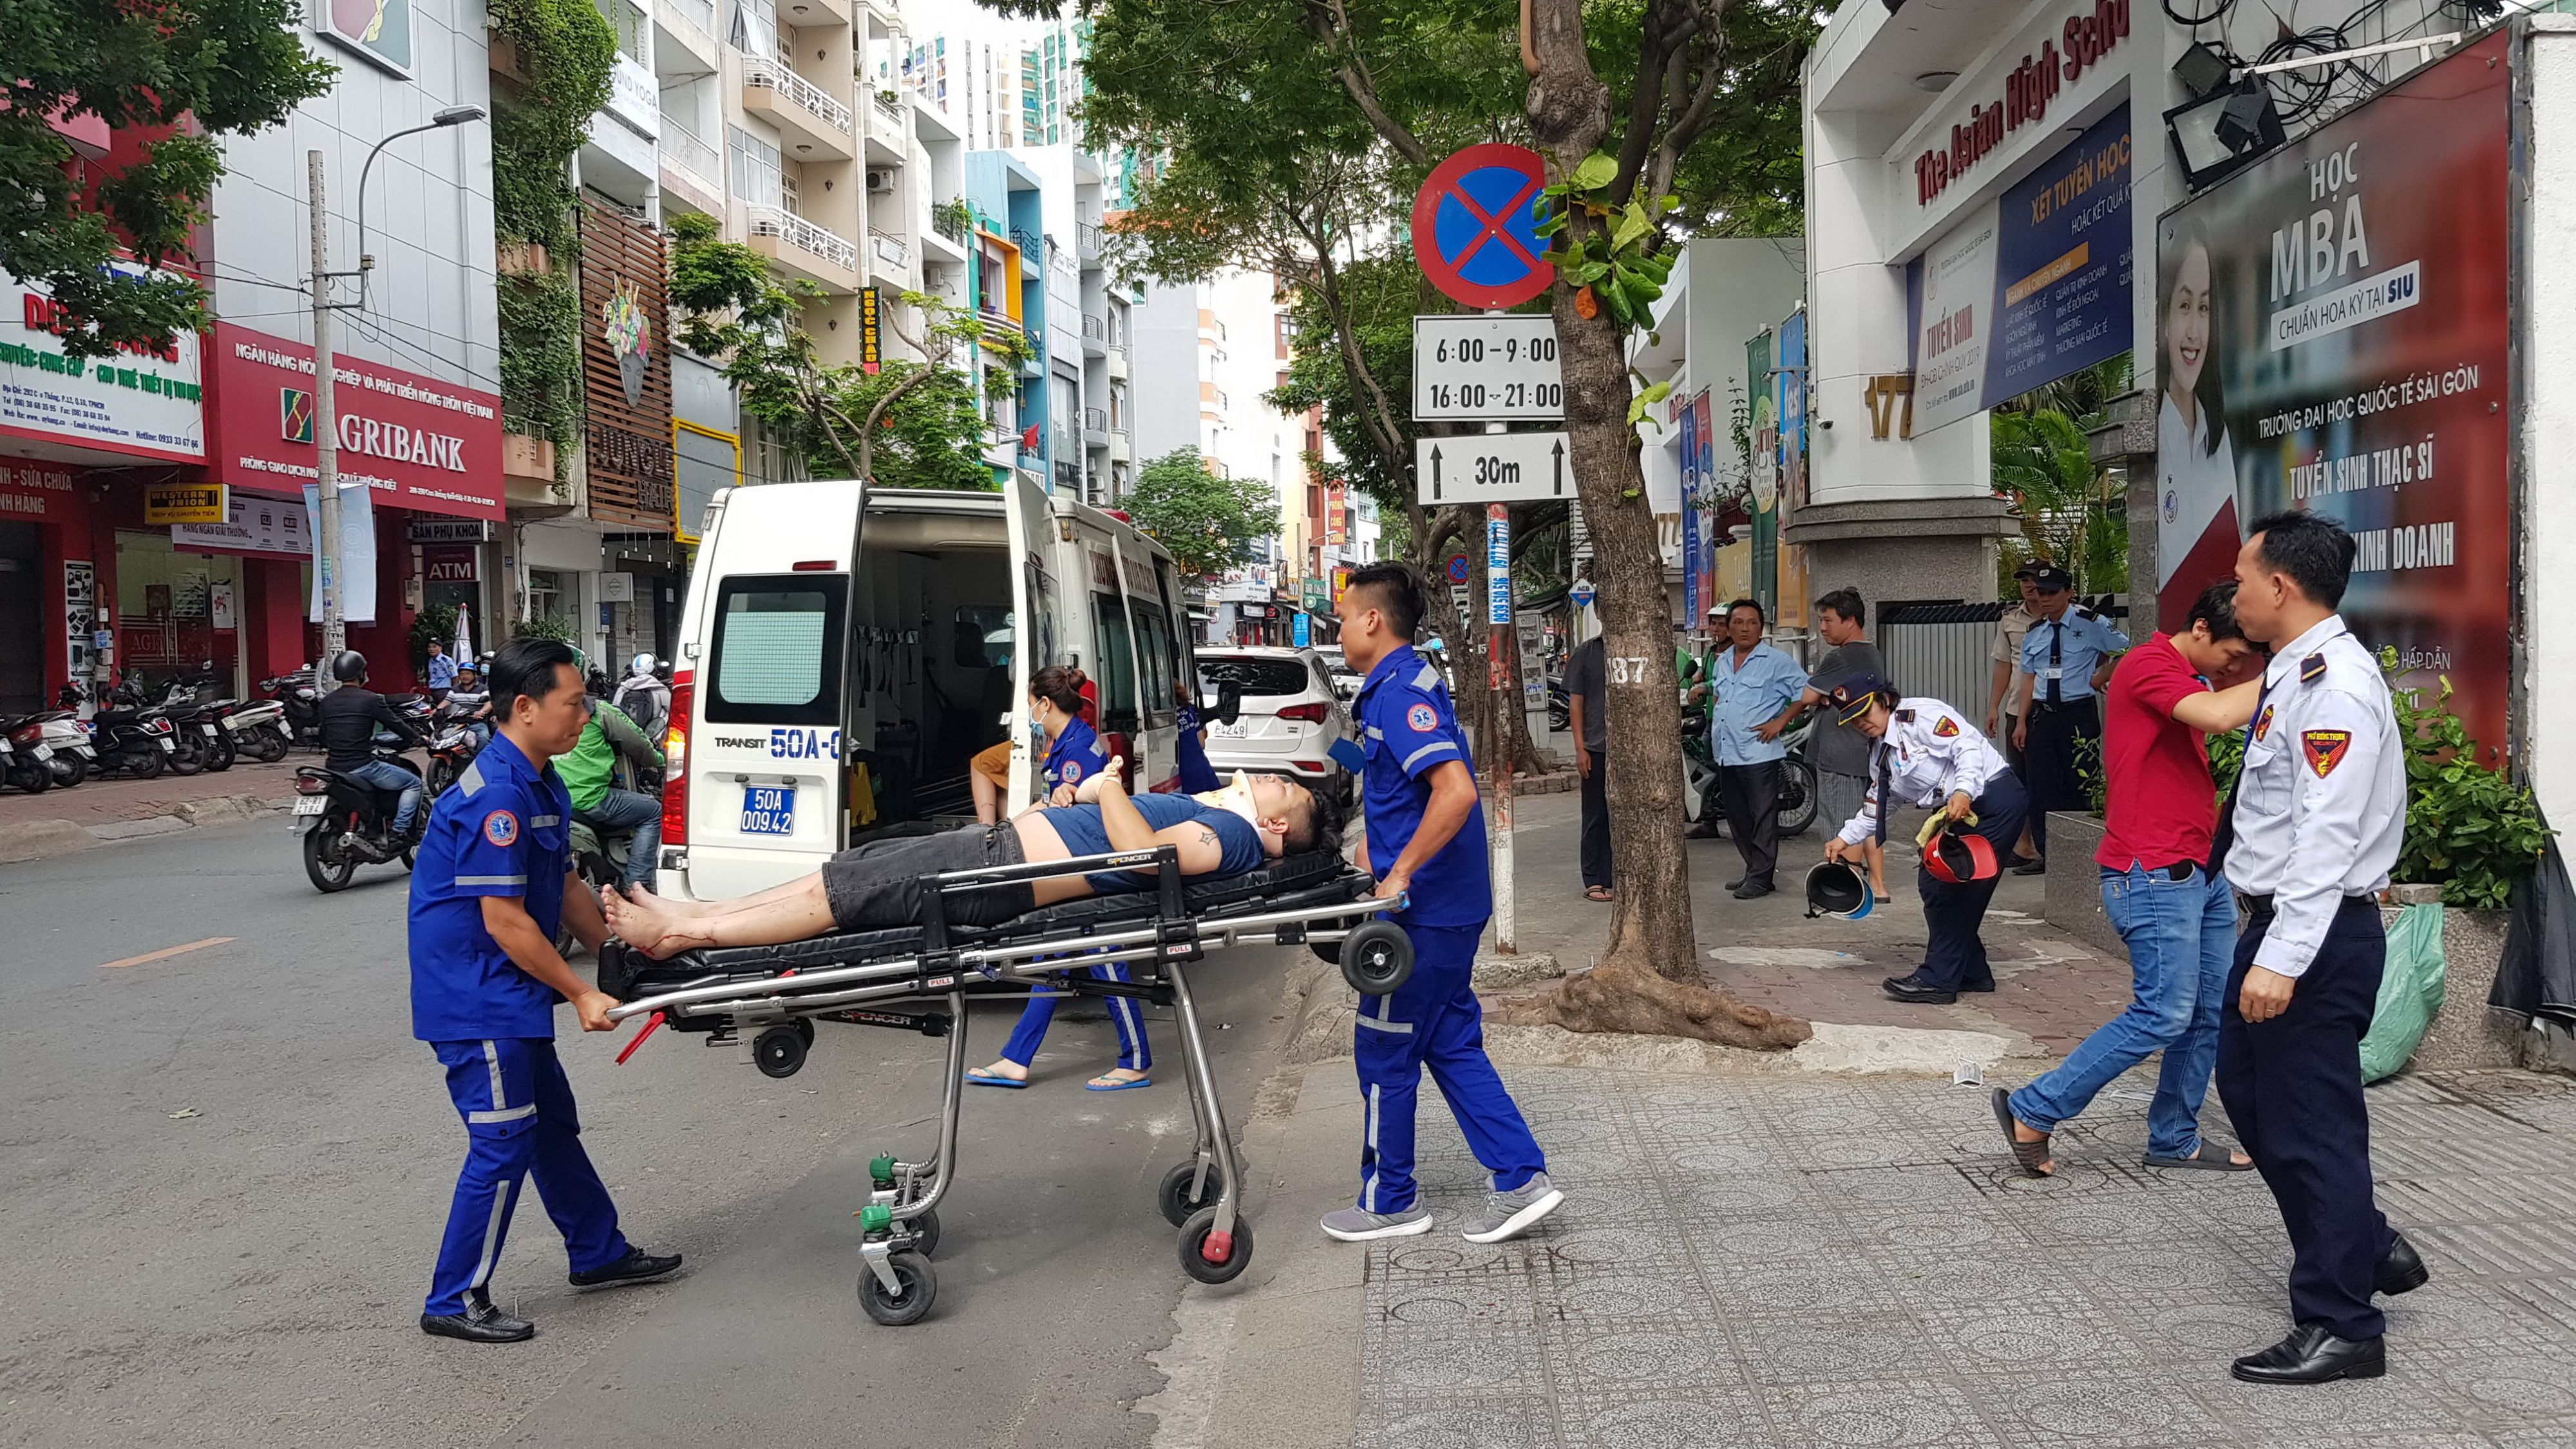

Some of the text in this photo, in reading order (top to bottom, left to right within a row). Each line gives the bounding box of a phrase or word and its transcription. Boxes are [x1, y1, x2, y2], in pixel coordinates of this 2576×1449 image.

[634, 80, 658, 111] YOGA
[1915, 150, 1947, 206] The
[1949, 100, 2003, 179] Asian
[2006, 39, 2060, 132] High
[2031, 133, 2130, 227] XÉT TUYỂN HỌC
[2311, 142, 2358, 202] HỌC
[2072, 184, 2124, 236] HOẶC KẾT QUẢ
[2271, 193, 2370, 303] MBA
[2088, 263, 2108, 285] DOANH
[2279, 272, 2414, 340] CHUẨN HOA KỲ TẠI SIU
[1927, 303, 1973, 361] TUYỂN SINH
[234, 343, 297, 372] NGÂN HÀNG
[1436, 337, 1556, 363] 6:00 9:00
[39, 351, 65, 374] CUNG
[97, 363, 115, 384] CHO
[117, 368, 138, 390] THUÊ
[363, 372, 374, 391] VÀ
[419, 388, 442, 406] NÔNG
[1430, 382, 1562, 410] 16:00 21:00
[2259, 362, 2479, 439] TRƯỜNG ĐẠI HỌC QUỐC TẾ SÀI GÒN
[1865, 374, 1912, 440] 177
[158, 433, 173, 445] 0933
[174, 435, 182, 446] 33
[600, 430, 674, 476] JUNGLE
[21, 463, 73, 492] SỬA CHỮA
[240, 455, 267, 471] PHÒNG
[268, 460, 288, 475] GIAO
[1474, 455, 1520, 486] 30m
[2289, 433, 2434, 500] TUYỂN SINH THẠC SĨ
[151, 491, 206, 500] WESTERN
[168, 498, 206, 507] UNION
[638, 479, 674, 516] HAIR
[434, 523, 452, 540] PHỤ
[455, 524, 481, 538] KHOA
[2393, 522, 2454, 570] DOANH
[429, 562, 471, 580] ATM
[1492, 577, 1509, 623] 0939 510 516
[2401, 645, 2424, 668] HẤP
[715, 737, 766, 749] TRANSIT
[755, 790, 782, 811] 50A
[742, 810, 791, 833] 009.42
[1106, 853, 1152, 867] SPENCER
[930, 978, 952, 986] PULL
[840, 1010, 911, 1025] SPENCER
